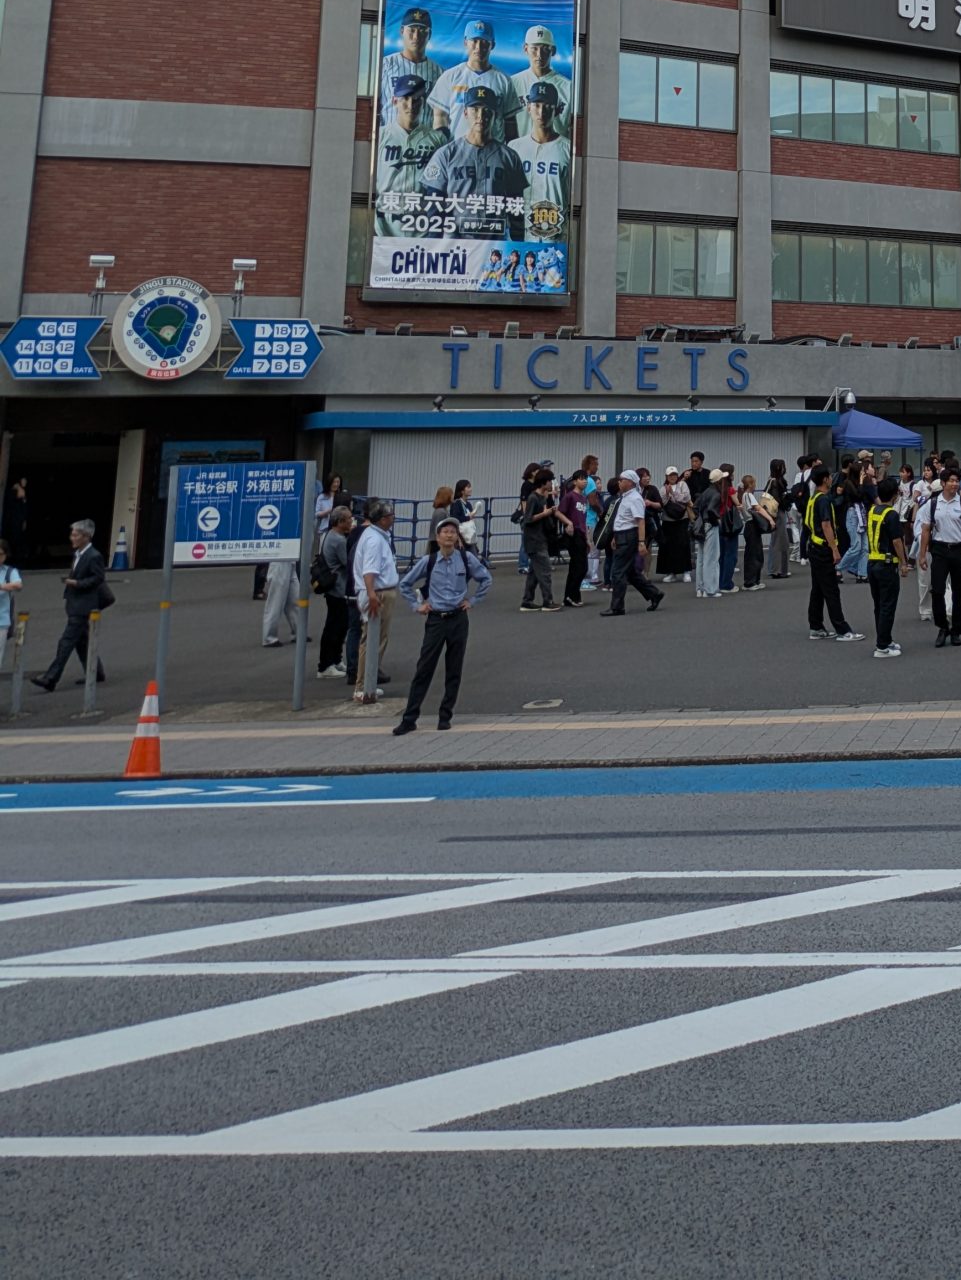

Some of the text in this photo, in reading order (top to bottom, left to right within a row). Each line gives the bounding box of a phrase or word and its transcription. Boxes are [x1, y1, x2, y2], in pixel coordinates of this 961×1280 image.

[382, 191, 526, 216] 東京六大学野球
[401, 215, 457, 233] 2025
[139, 279, 164, 294] JINGU
[166, 278, 204, 295] STADIUM
[42, 324, 75, 334] 16 15
[276, 326, 288, 334] 18
[294, 326, 306, 334] 17
[20, 342, 73, 352] 14 13 12
[18, 361, 30, 370] 11
[38, 361, 52, 370] 10
[442, 343, 750, 391] TICKETS
[572, 414, 677, 422] 7入口横 チケットボックス
[196, 472, 207, 480] JR
[247, 470, 275, 478] 東京メトロ
[246, 478, 295, 493] 外苑前駅
